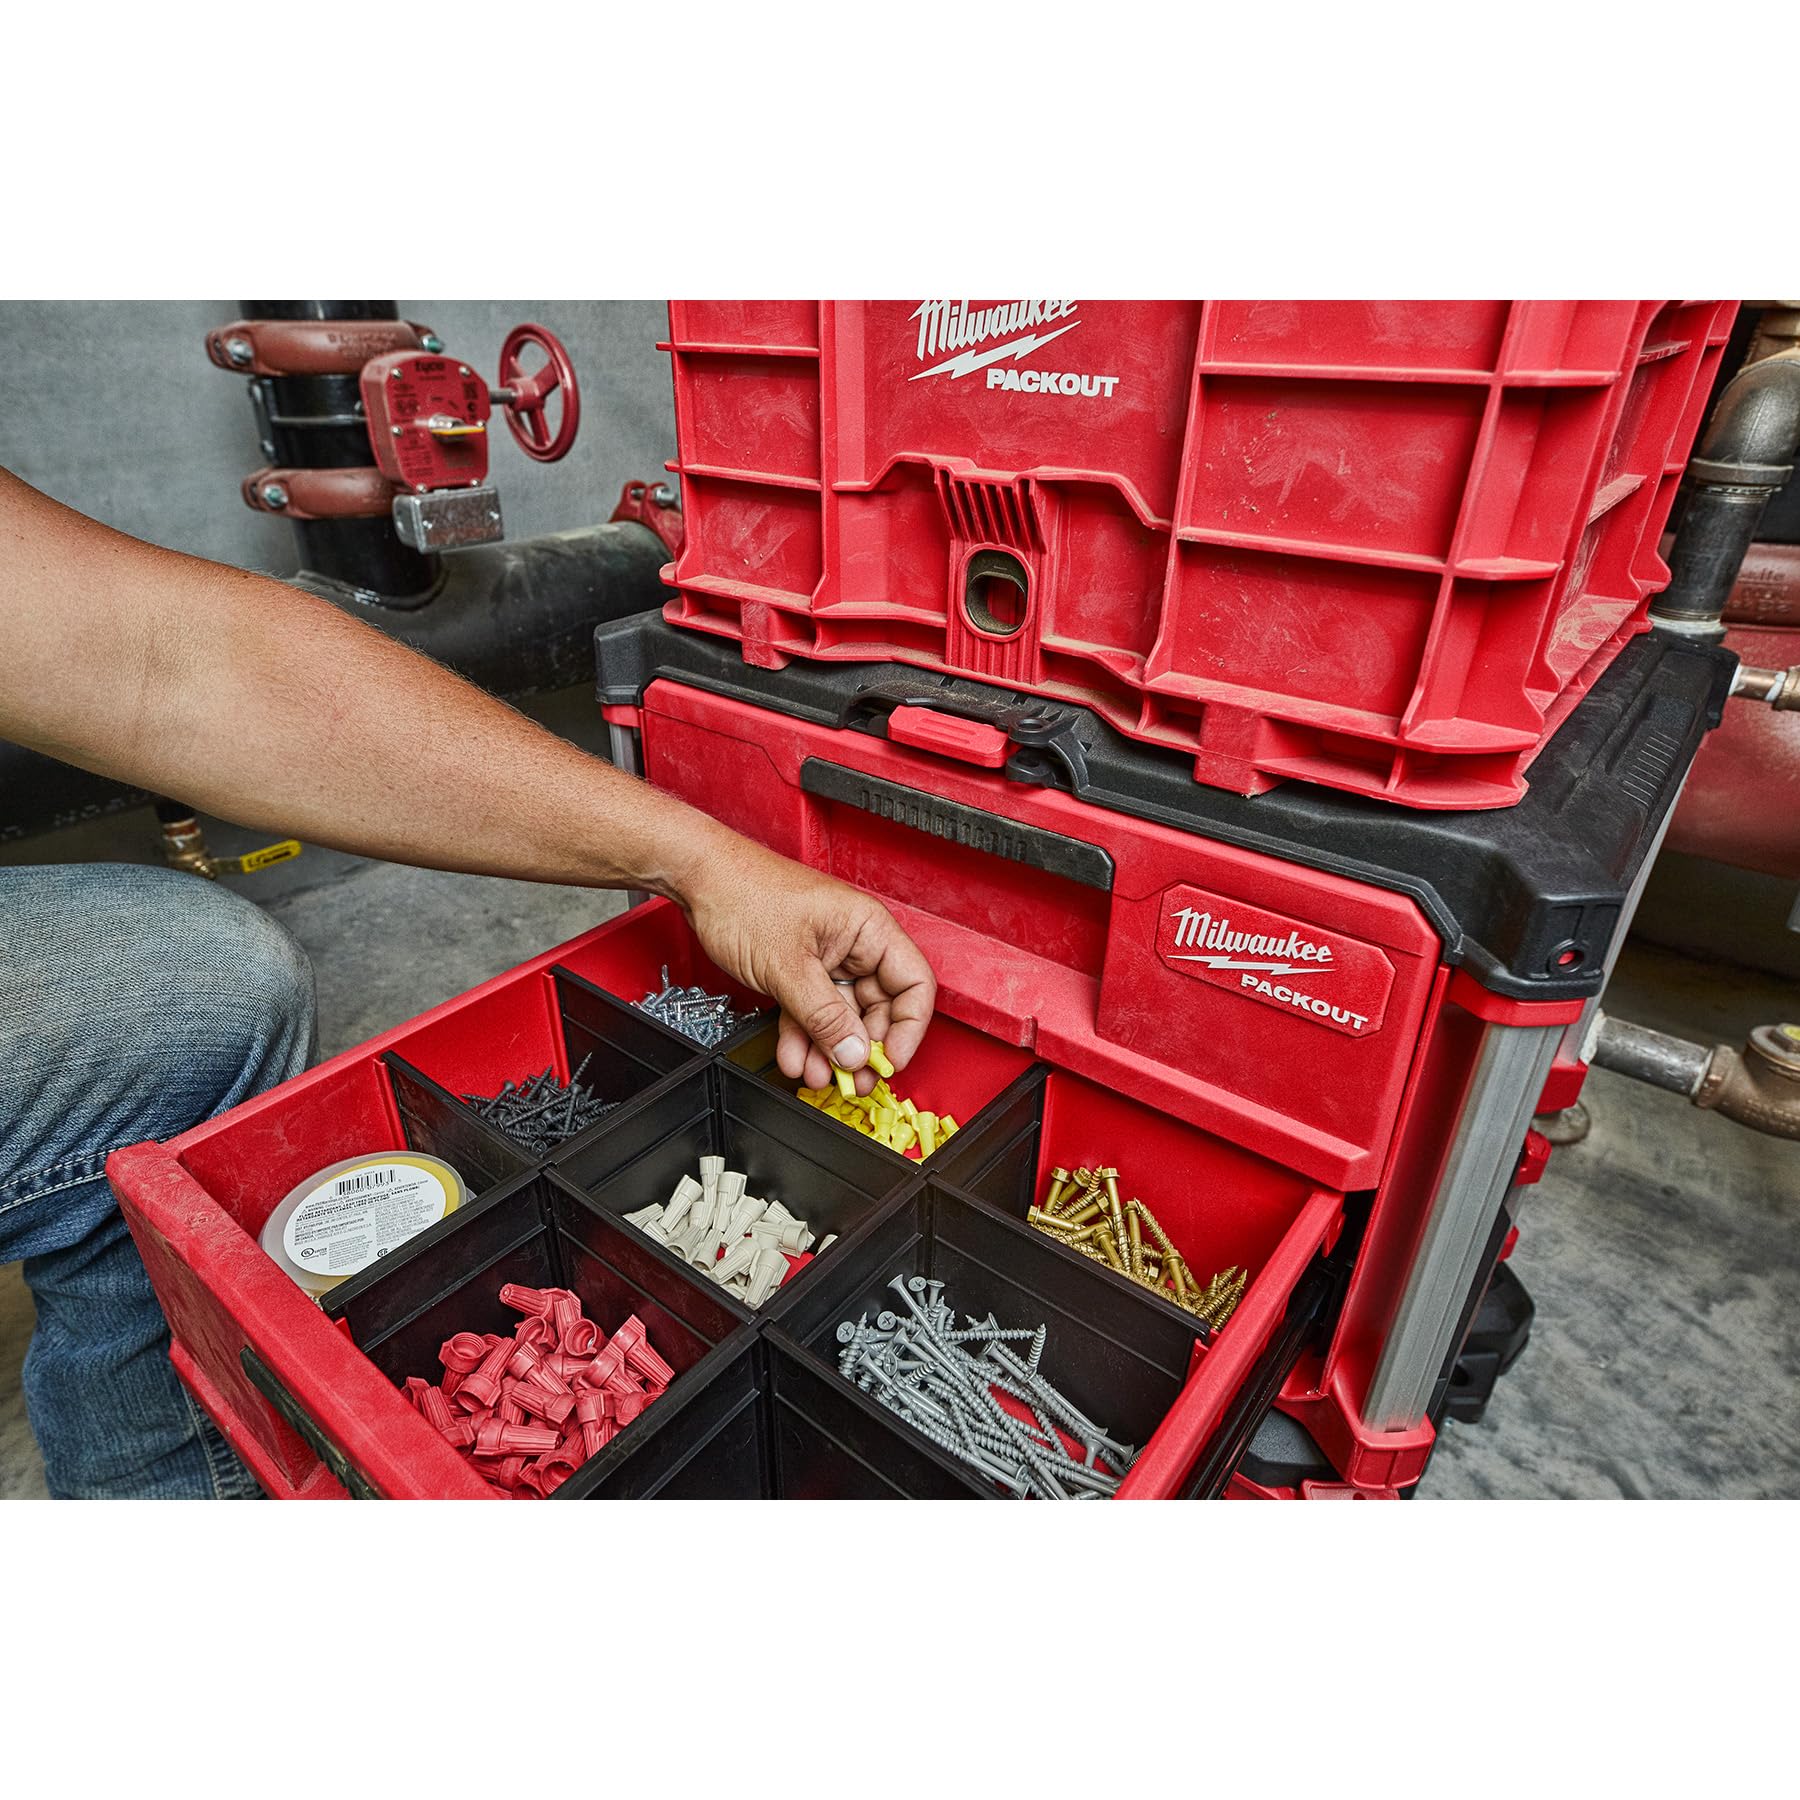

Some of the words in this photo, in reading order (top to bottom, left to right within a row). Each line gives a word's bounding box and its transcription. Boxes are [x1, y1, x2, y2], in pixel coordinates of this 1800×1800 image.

[908, 300, 1078, 361] Milwaukee
[986, 368, 1119, 398] PACKOUT
[1170, 907, 1333, 963] Milwaukee
[1240, 973, 1368, 1030] PACKOUT
